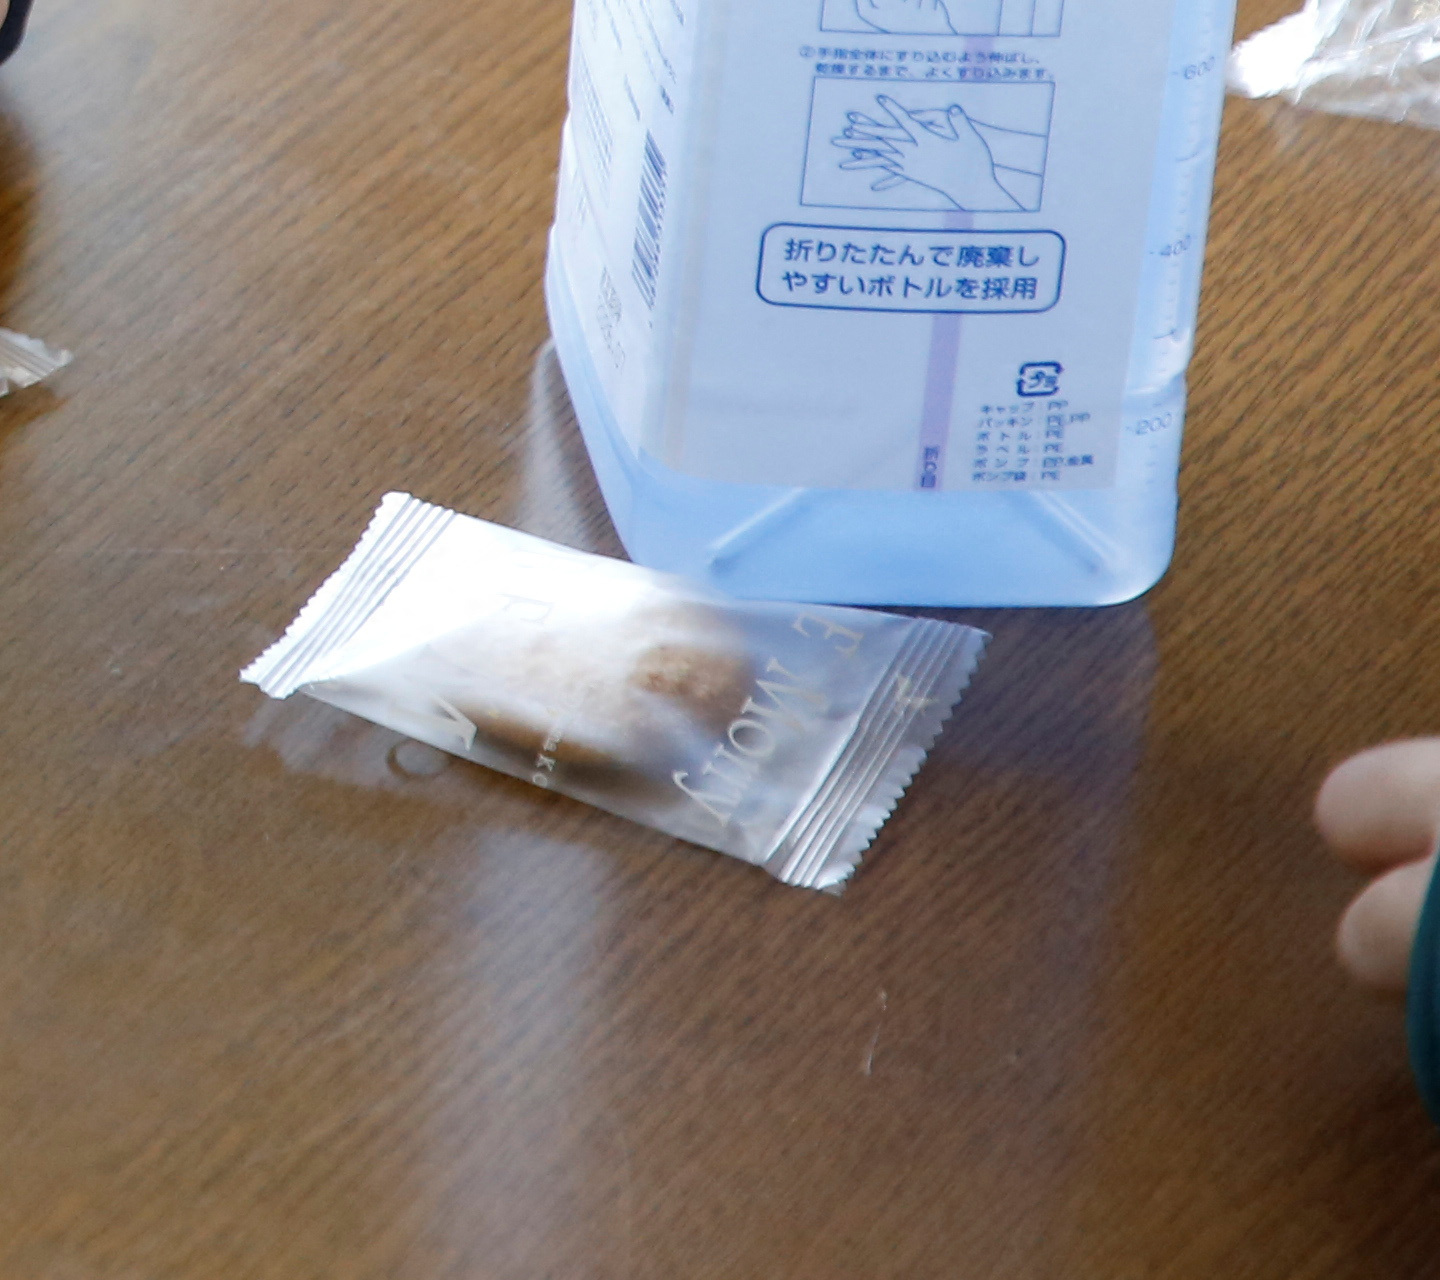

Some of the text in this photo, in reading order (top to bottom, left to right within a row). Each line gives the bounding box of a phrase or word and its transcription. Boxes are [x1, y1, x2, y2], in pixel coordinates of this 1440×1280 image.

[783, 237, 1040, 269] 折りたたんで廃棄し
[781, 271, 1037, 302] やすいボトルを採用
